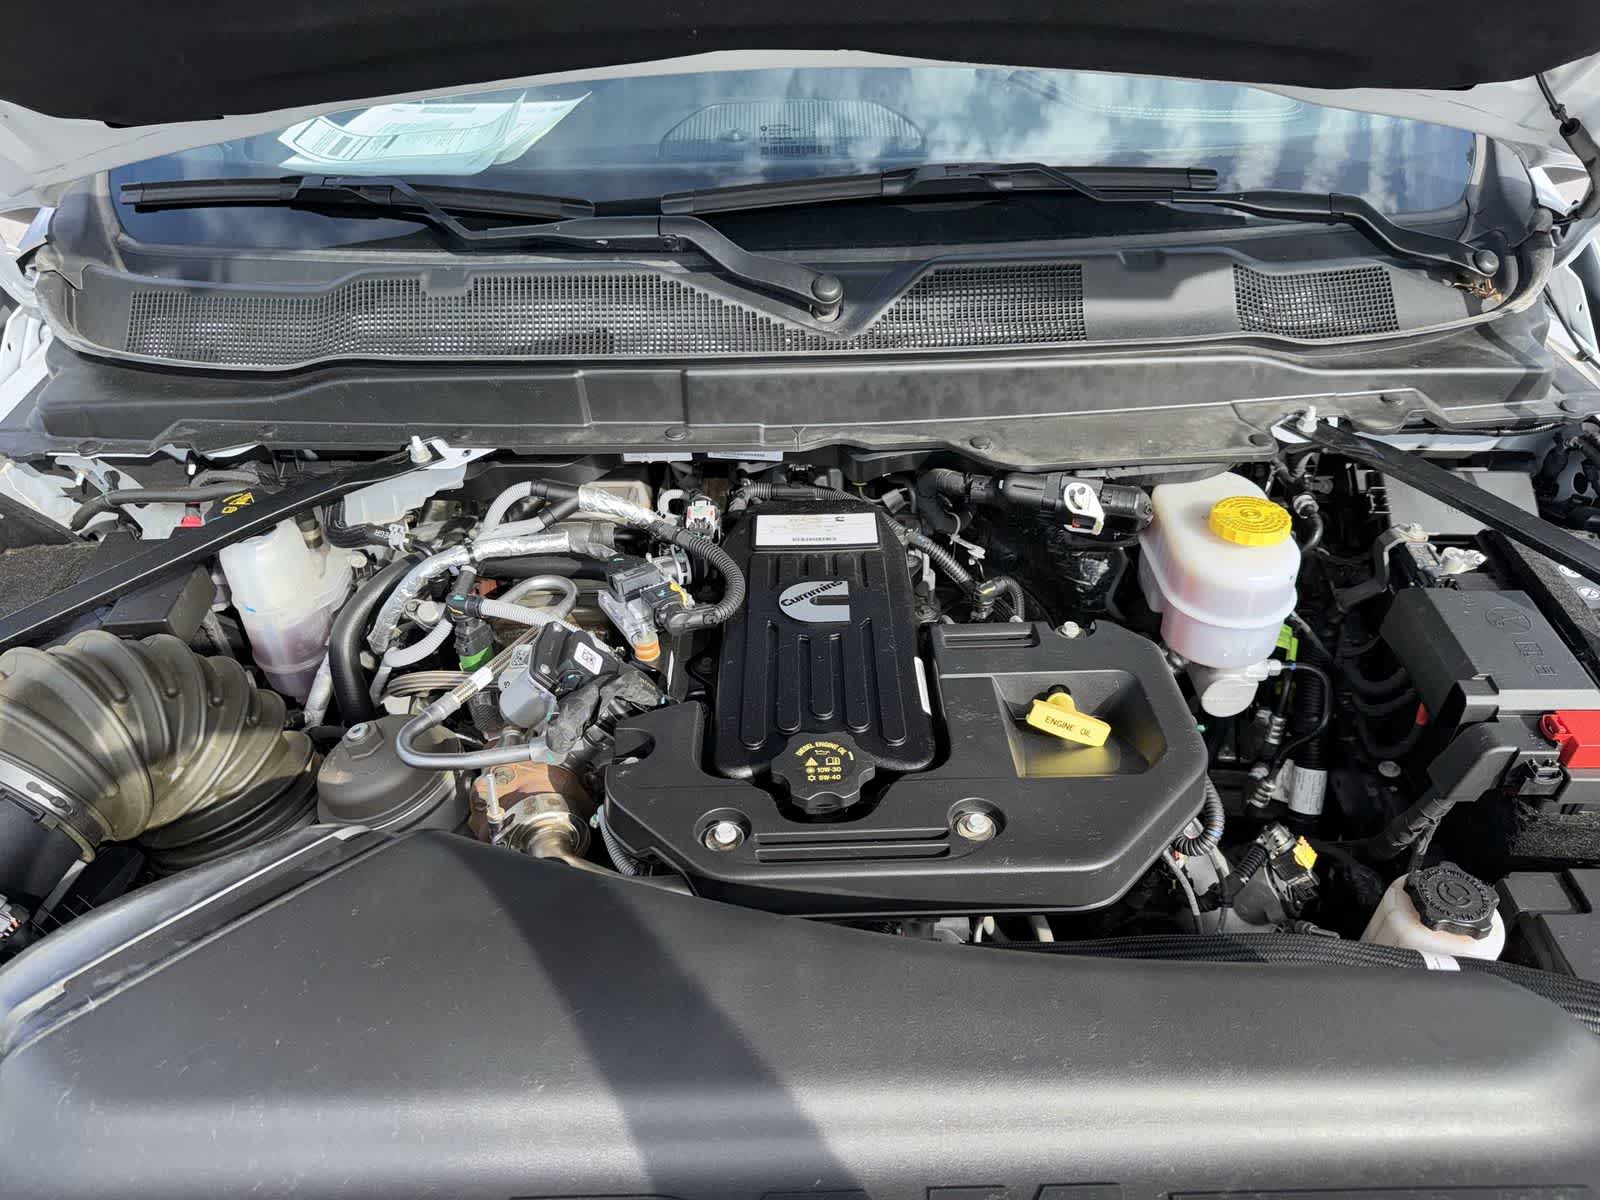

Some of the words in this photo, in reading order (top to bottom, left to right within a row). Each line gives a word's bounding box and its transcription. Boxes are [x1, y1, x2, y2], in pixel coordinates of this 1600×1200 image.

[780, 581, 843, 606] Cummins
[1044, 715, 1074, 732] ENGINE
[1080, 727, 1091, 738] OIL
